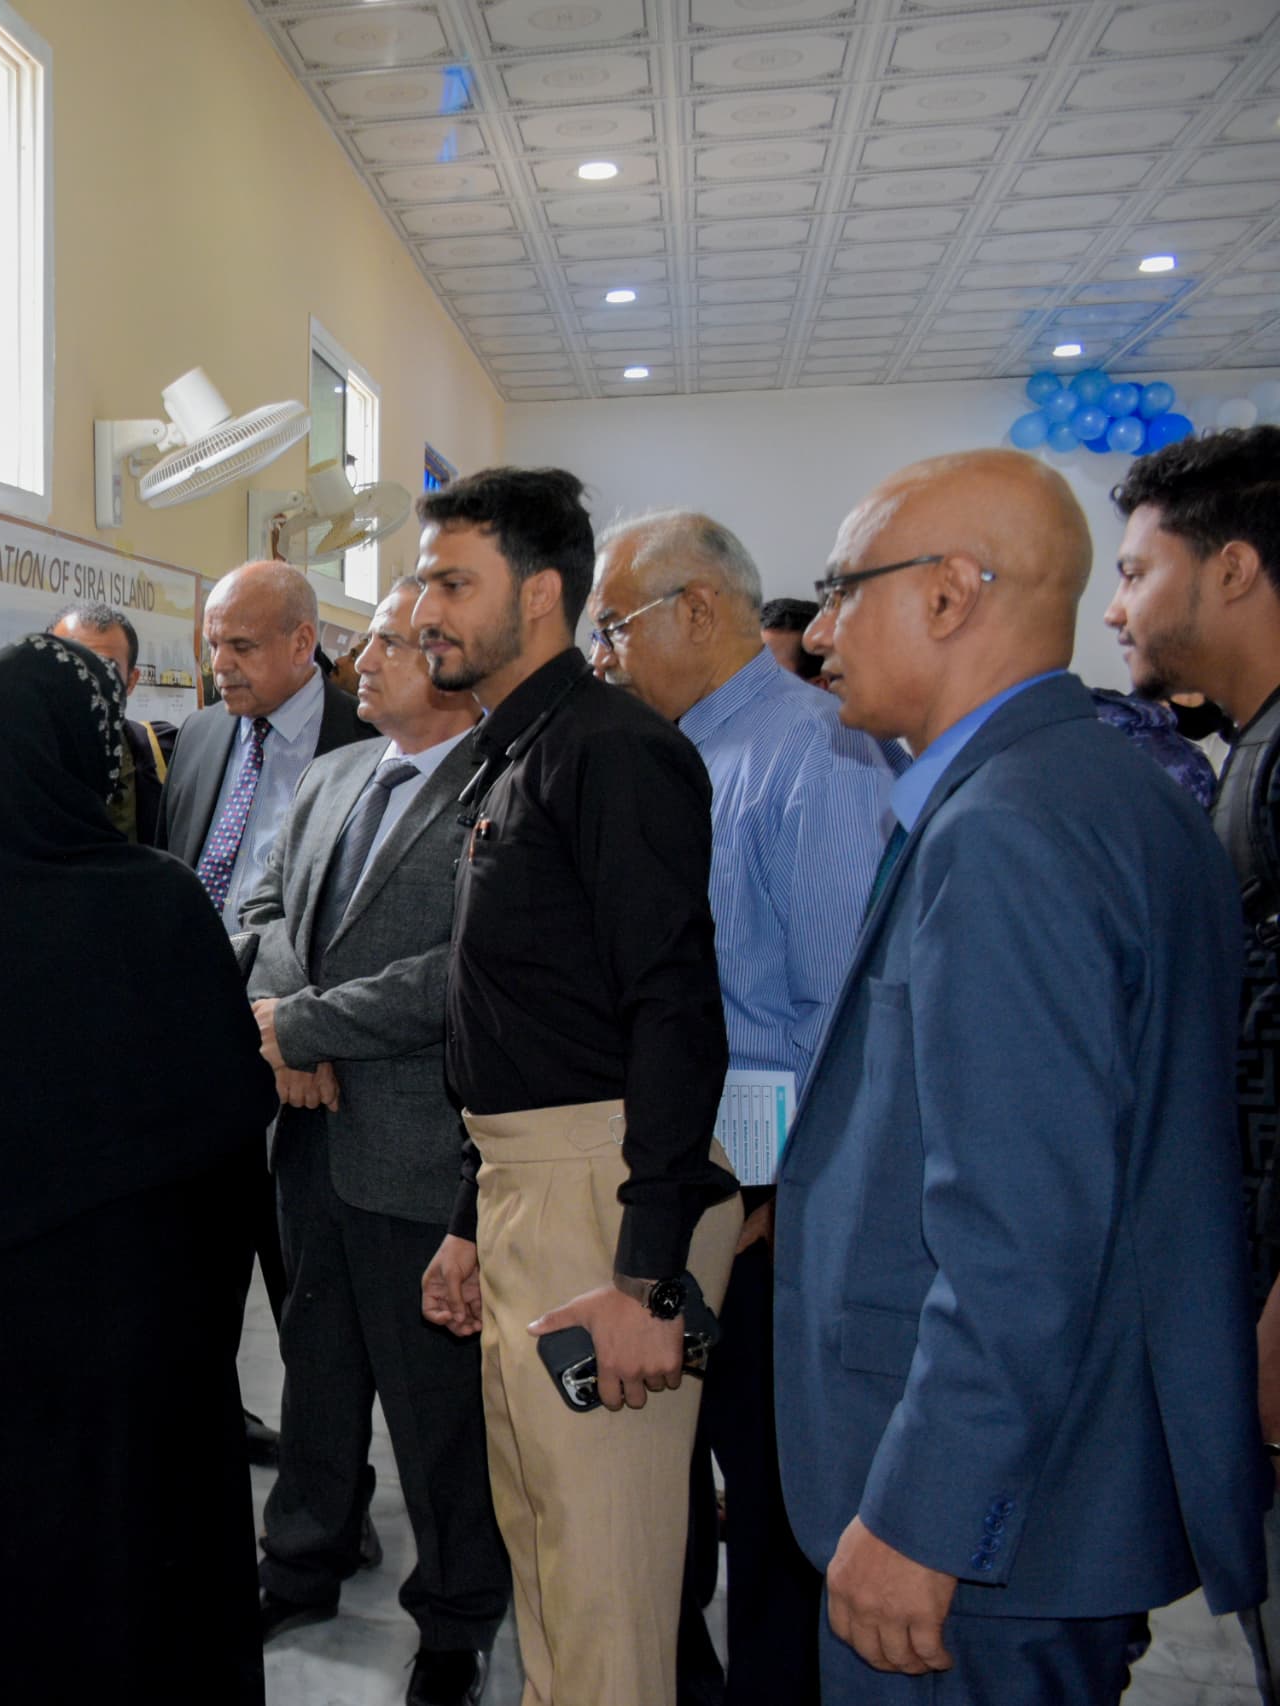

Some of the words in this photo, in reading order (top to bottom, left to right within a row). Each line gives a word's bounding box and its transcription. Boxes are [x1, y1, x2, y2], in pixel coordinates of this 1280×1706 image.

[49, 556, 70, 594] OF
[74, 563, 107, 601] SIRA
[110, 571, 155, 612] ISLAND
